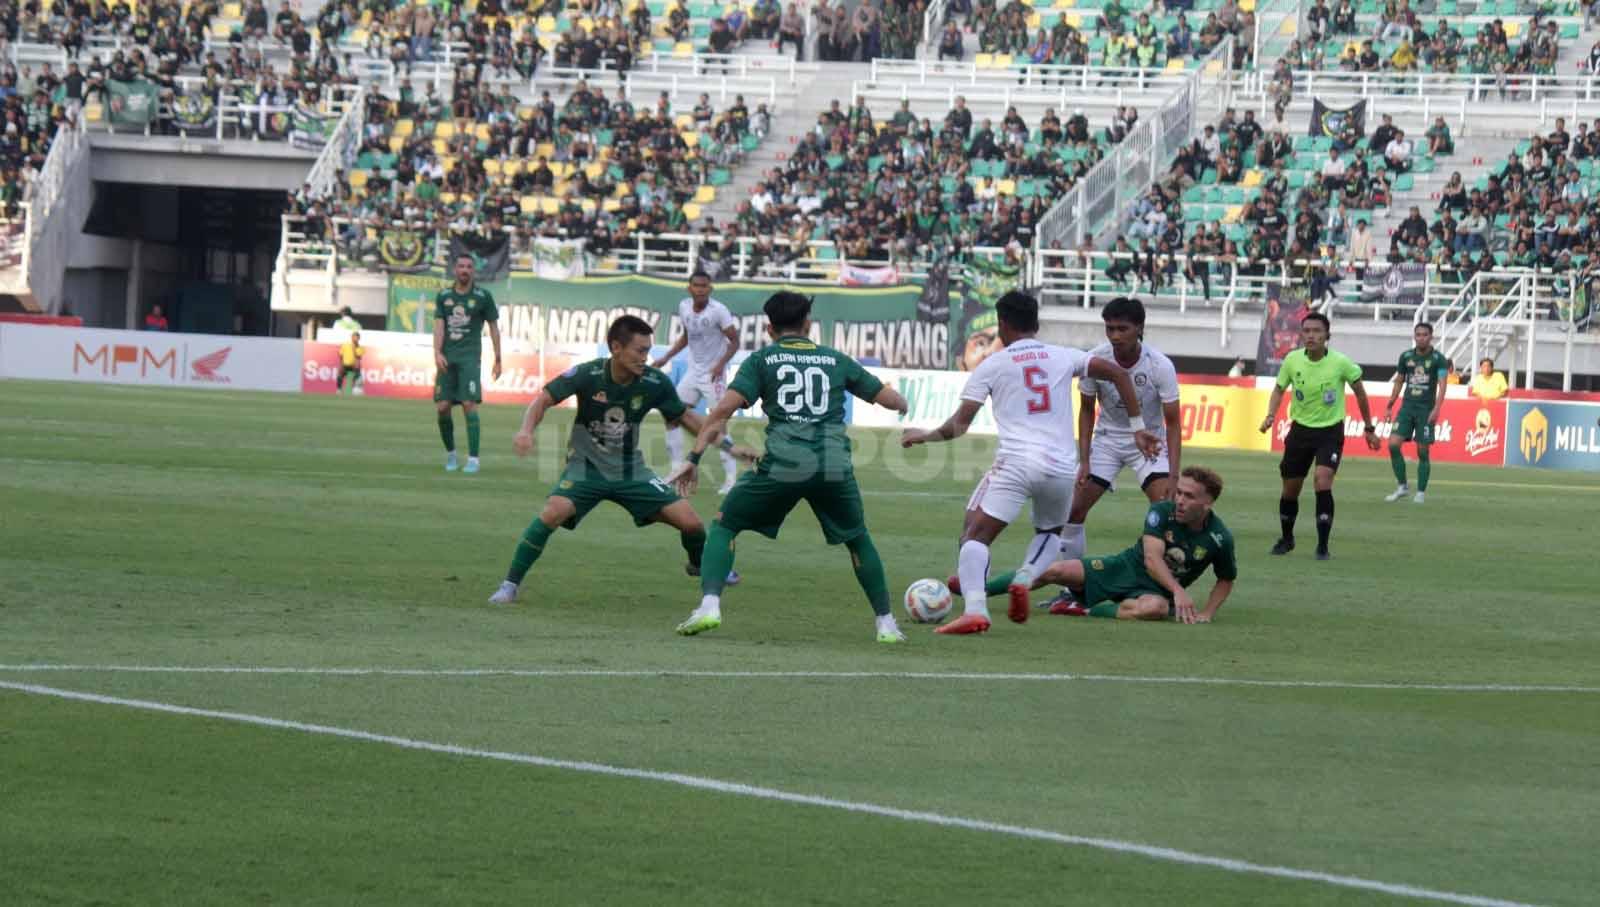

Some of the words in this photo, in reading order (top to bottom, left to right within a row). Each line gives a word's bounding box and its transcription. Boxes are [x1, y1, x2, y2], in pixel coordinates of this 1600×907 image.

[73, 343, 176, 380] MPM
[482, 304, 541, 341] AIN
[834, 318, 948, 370] MENANG
[765, 353, 796, 366] WILDAN
[797, 354, 836, 367] RAMDHANI
[776, 364, 831, 416] 20
[1023, 365, 1052, 415] 5
